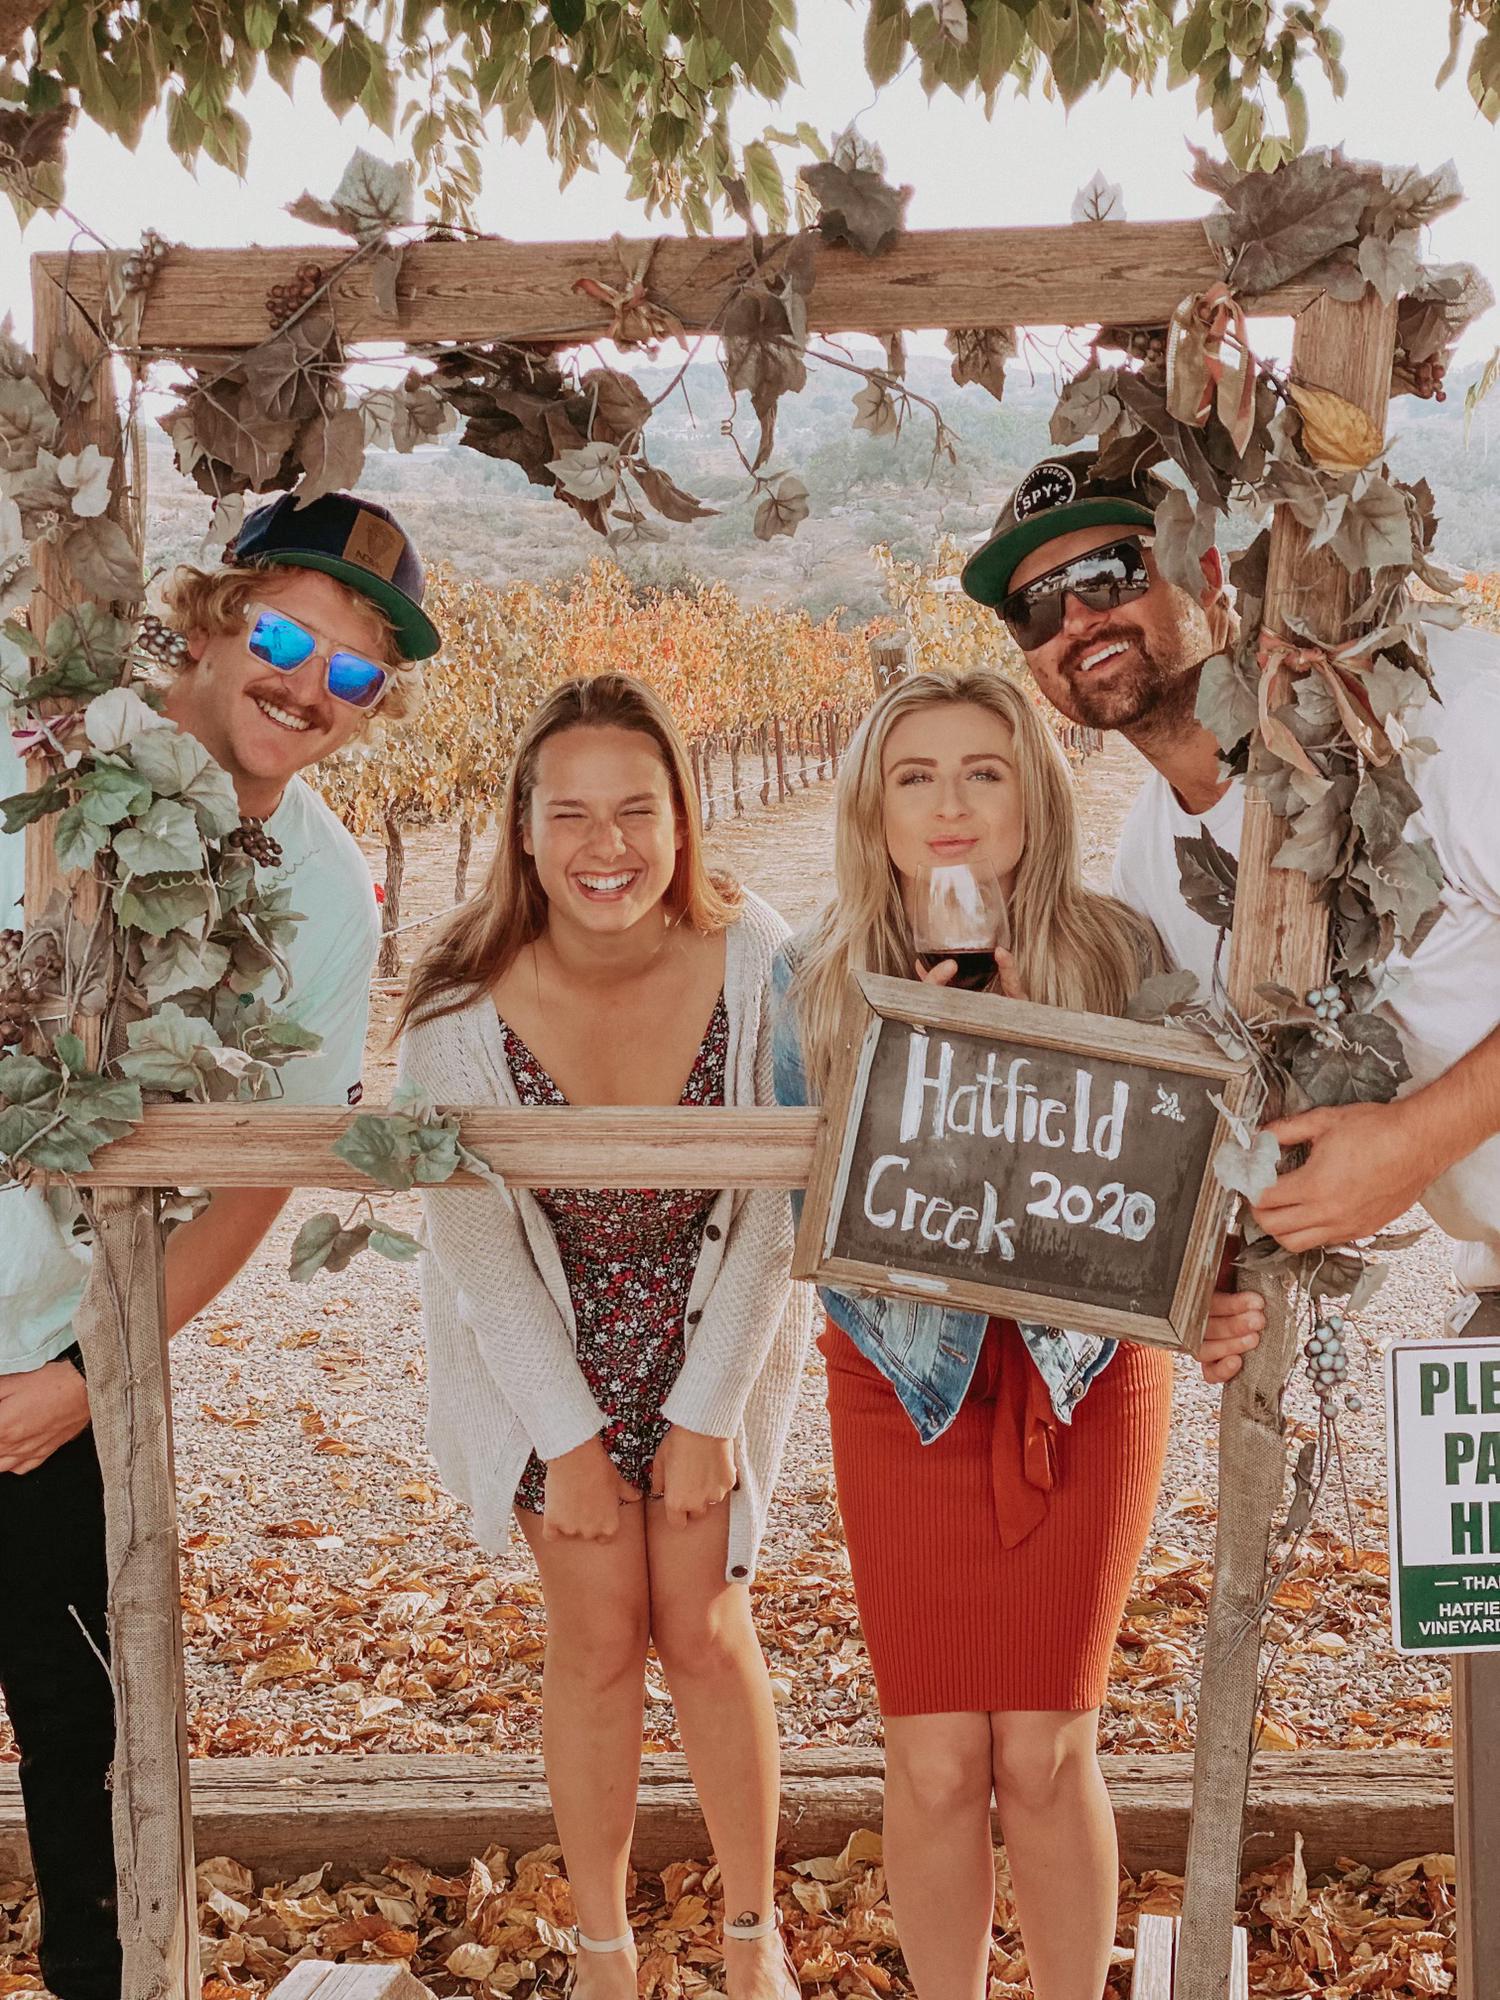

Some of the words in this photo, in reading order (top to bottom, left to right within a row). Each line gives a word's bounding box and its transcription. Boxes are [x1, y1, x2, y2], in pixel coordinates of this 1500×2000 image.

[1022, 483, 1063, 511] SPY+
[900, 1032, 1130, 1161] Hatfield
[863, 1154, 1016, 1262] Creek
[1026, 1171, 1156, 1241] 2020
[1462, 1575, 1500, 1591] THA
[1439, 1601, 1500, 1618] HATFIE
